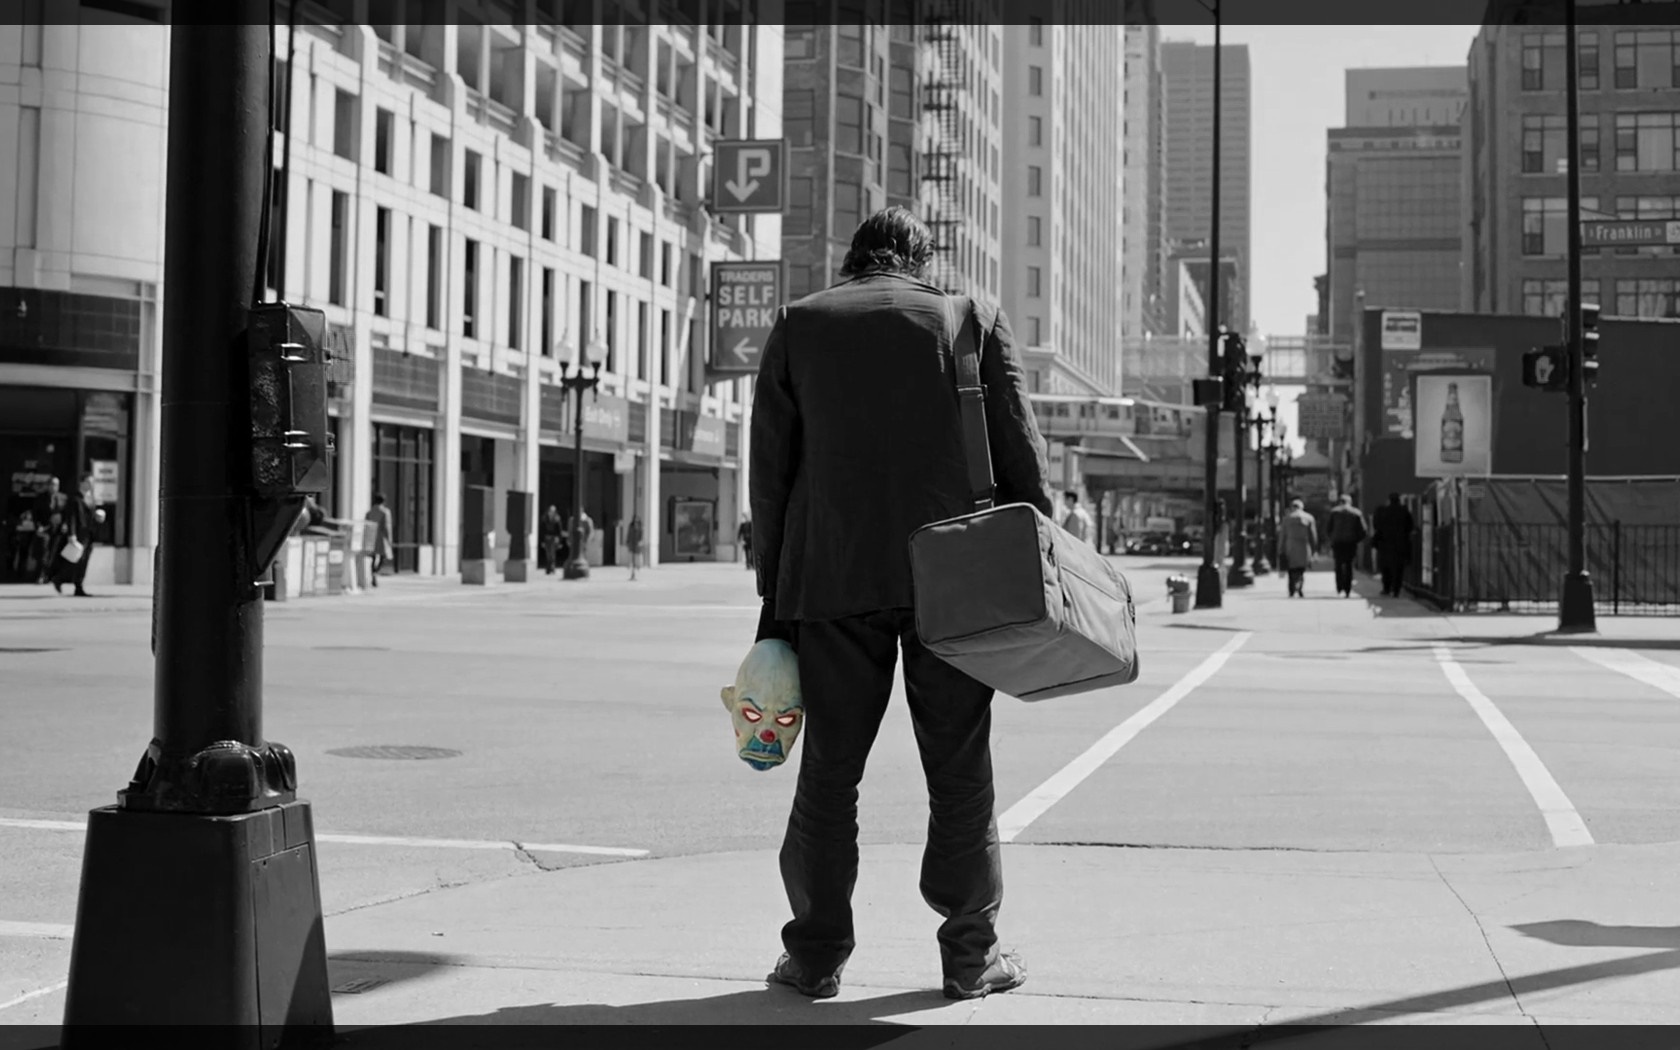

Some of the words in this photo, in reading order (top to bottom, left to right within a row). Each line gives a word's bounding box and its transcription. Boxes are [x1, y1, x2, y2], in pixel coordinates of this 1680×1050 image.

[1596, 224, 1652, 240] Franklin
[720, 270, 773, 282] TRADERS
[719, 285, 774, 305] SELF
[719, 308, 773, 328] PARK
